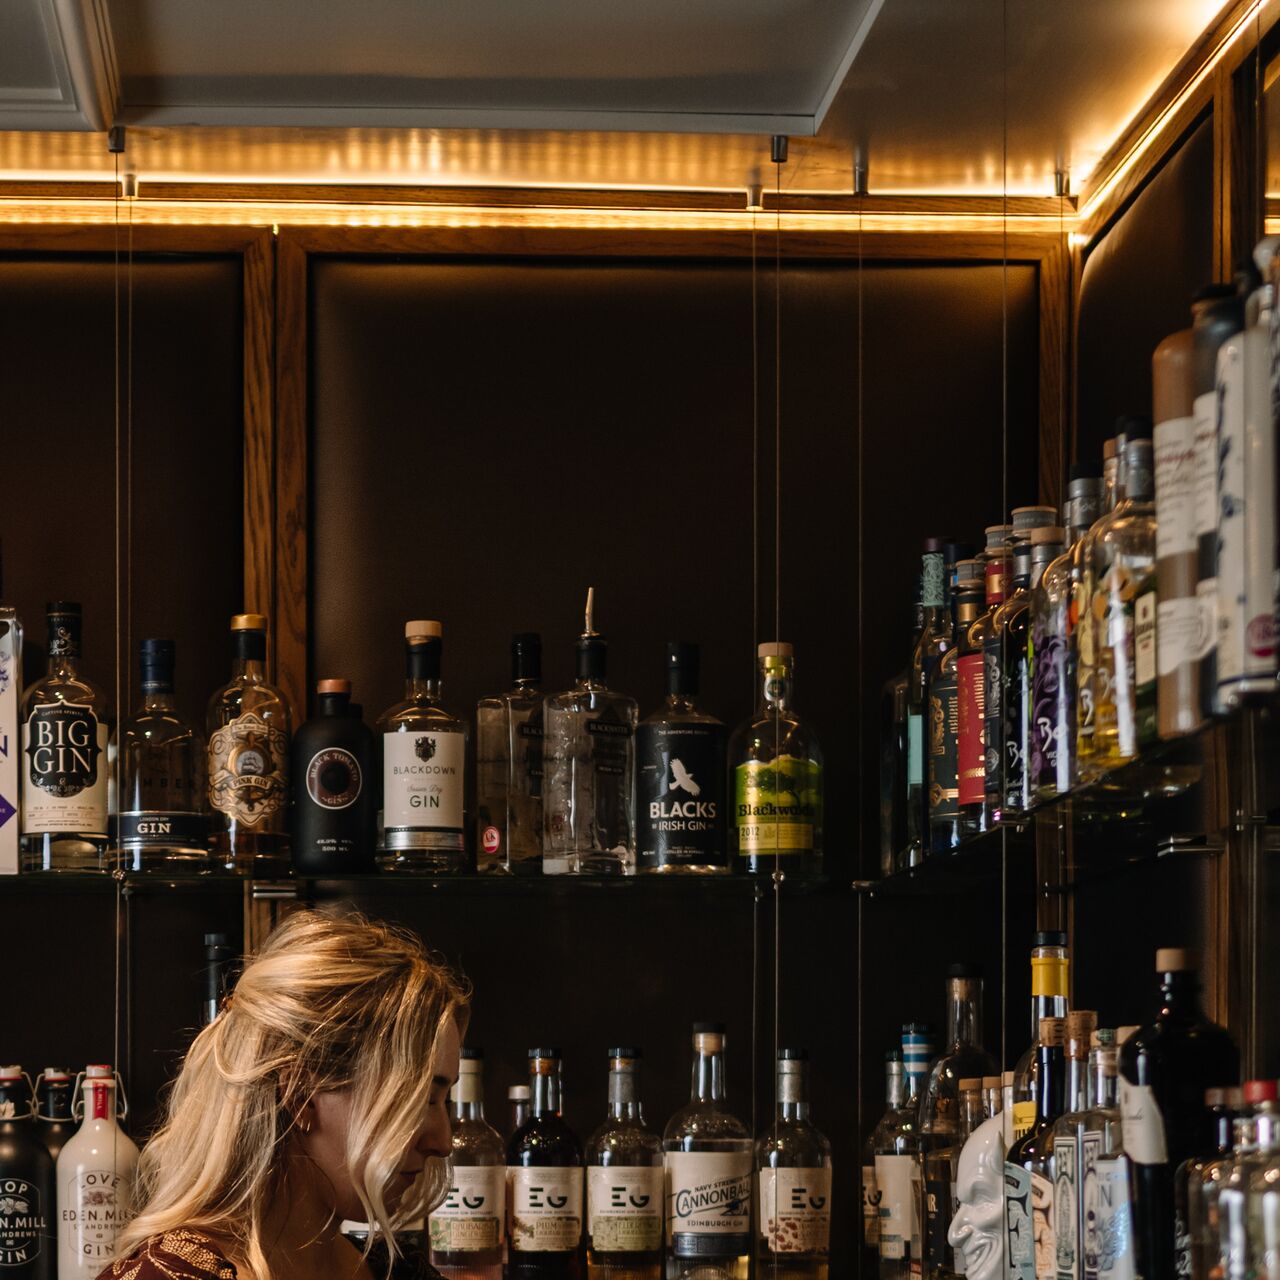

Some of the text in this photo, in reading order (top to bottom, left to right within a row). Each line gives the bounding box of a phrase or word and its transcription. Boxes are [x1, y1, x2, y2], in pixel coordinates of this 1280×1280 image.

[36, 720, 90, 748] BIG
[32, 748, 92, 774] GIN
[310, 753, 359, 782] BLACK TOMATO
[392, 766, 456, 775] BLACKDOWN
[233, 775, 270, 788] PINK GIN
[409, 795, 440, 809] GIN
[649, 802, 717, 819] BLACKS
[136, 823, 172, 834] GIN
[658, 820, 707, 831] IRISH GIN
[741, 827, 760, 837] 2012
[81, 1173, 120, 1191] OVE
[694, 1184, 713, 1193] NAVY
[529, 1187, 569, 1208] EG
[612, 1186, 652, 1208] EG
[676, 1180, 752, 1218] CANNONBALL
[791, 1188, 827, 1210] EG
[687, 1220, 732, 1228] EDINBURGH
[82, 1243, 117, 1257] GIN
